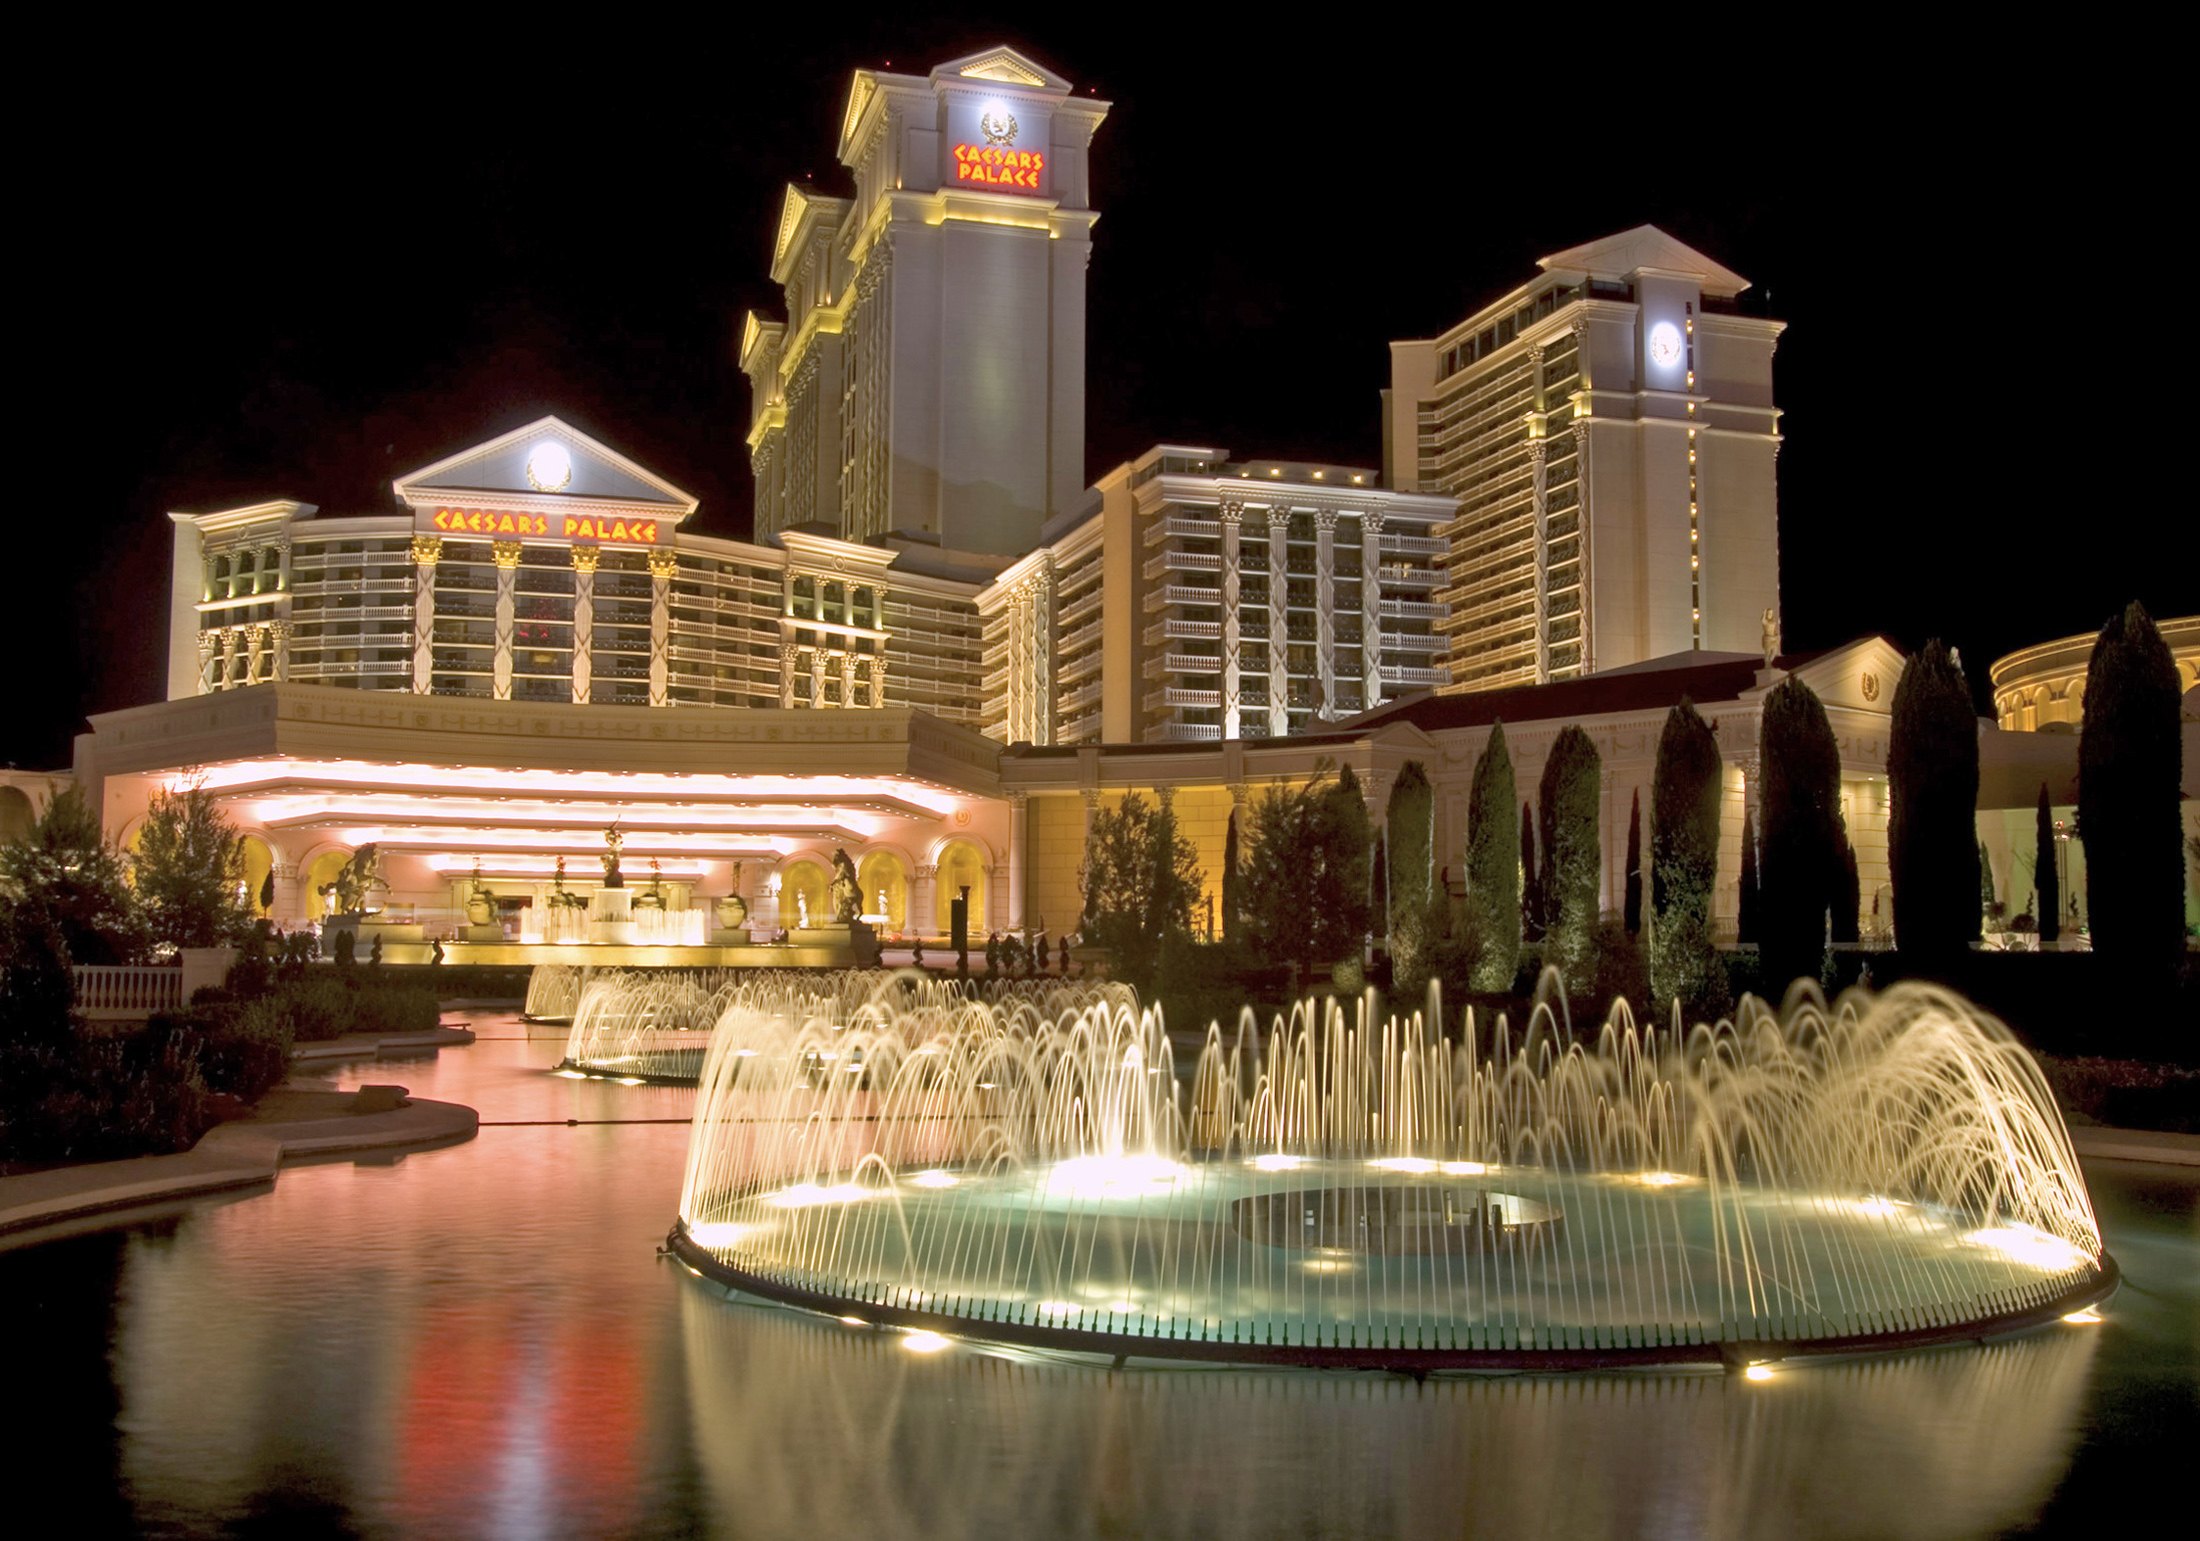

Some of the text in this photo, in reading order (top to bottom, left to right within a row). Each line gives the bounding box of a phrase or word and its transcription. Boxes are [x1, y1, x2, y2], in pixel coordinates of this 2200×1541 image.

[953, 143, 1045, 171] CAESARS
[958, 161, 1039, 188] PALACE
[433, 509, 656, 542] CAESARS PALACE
